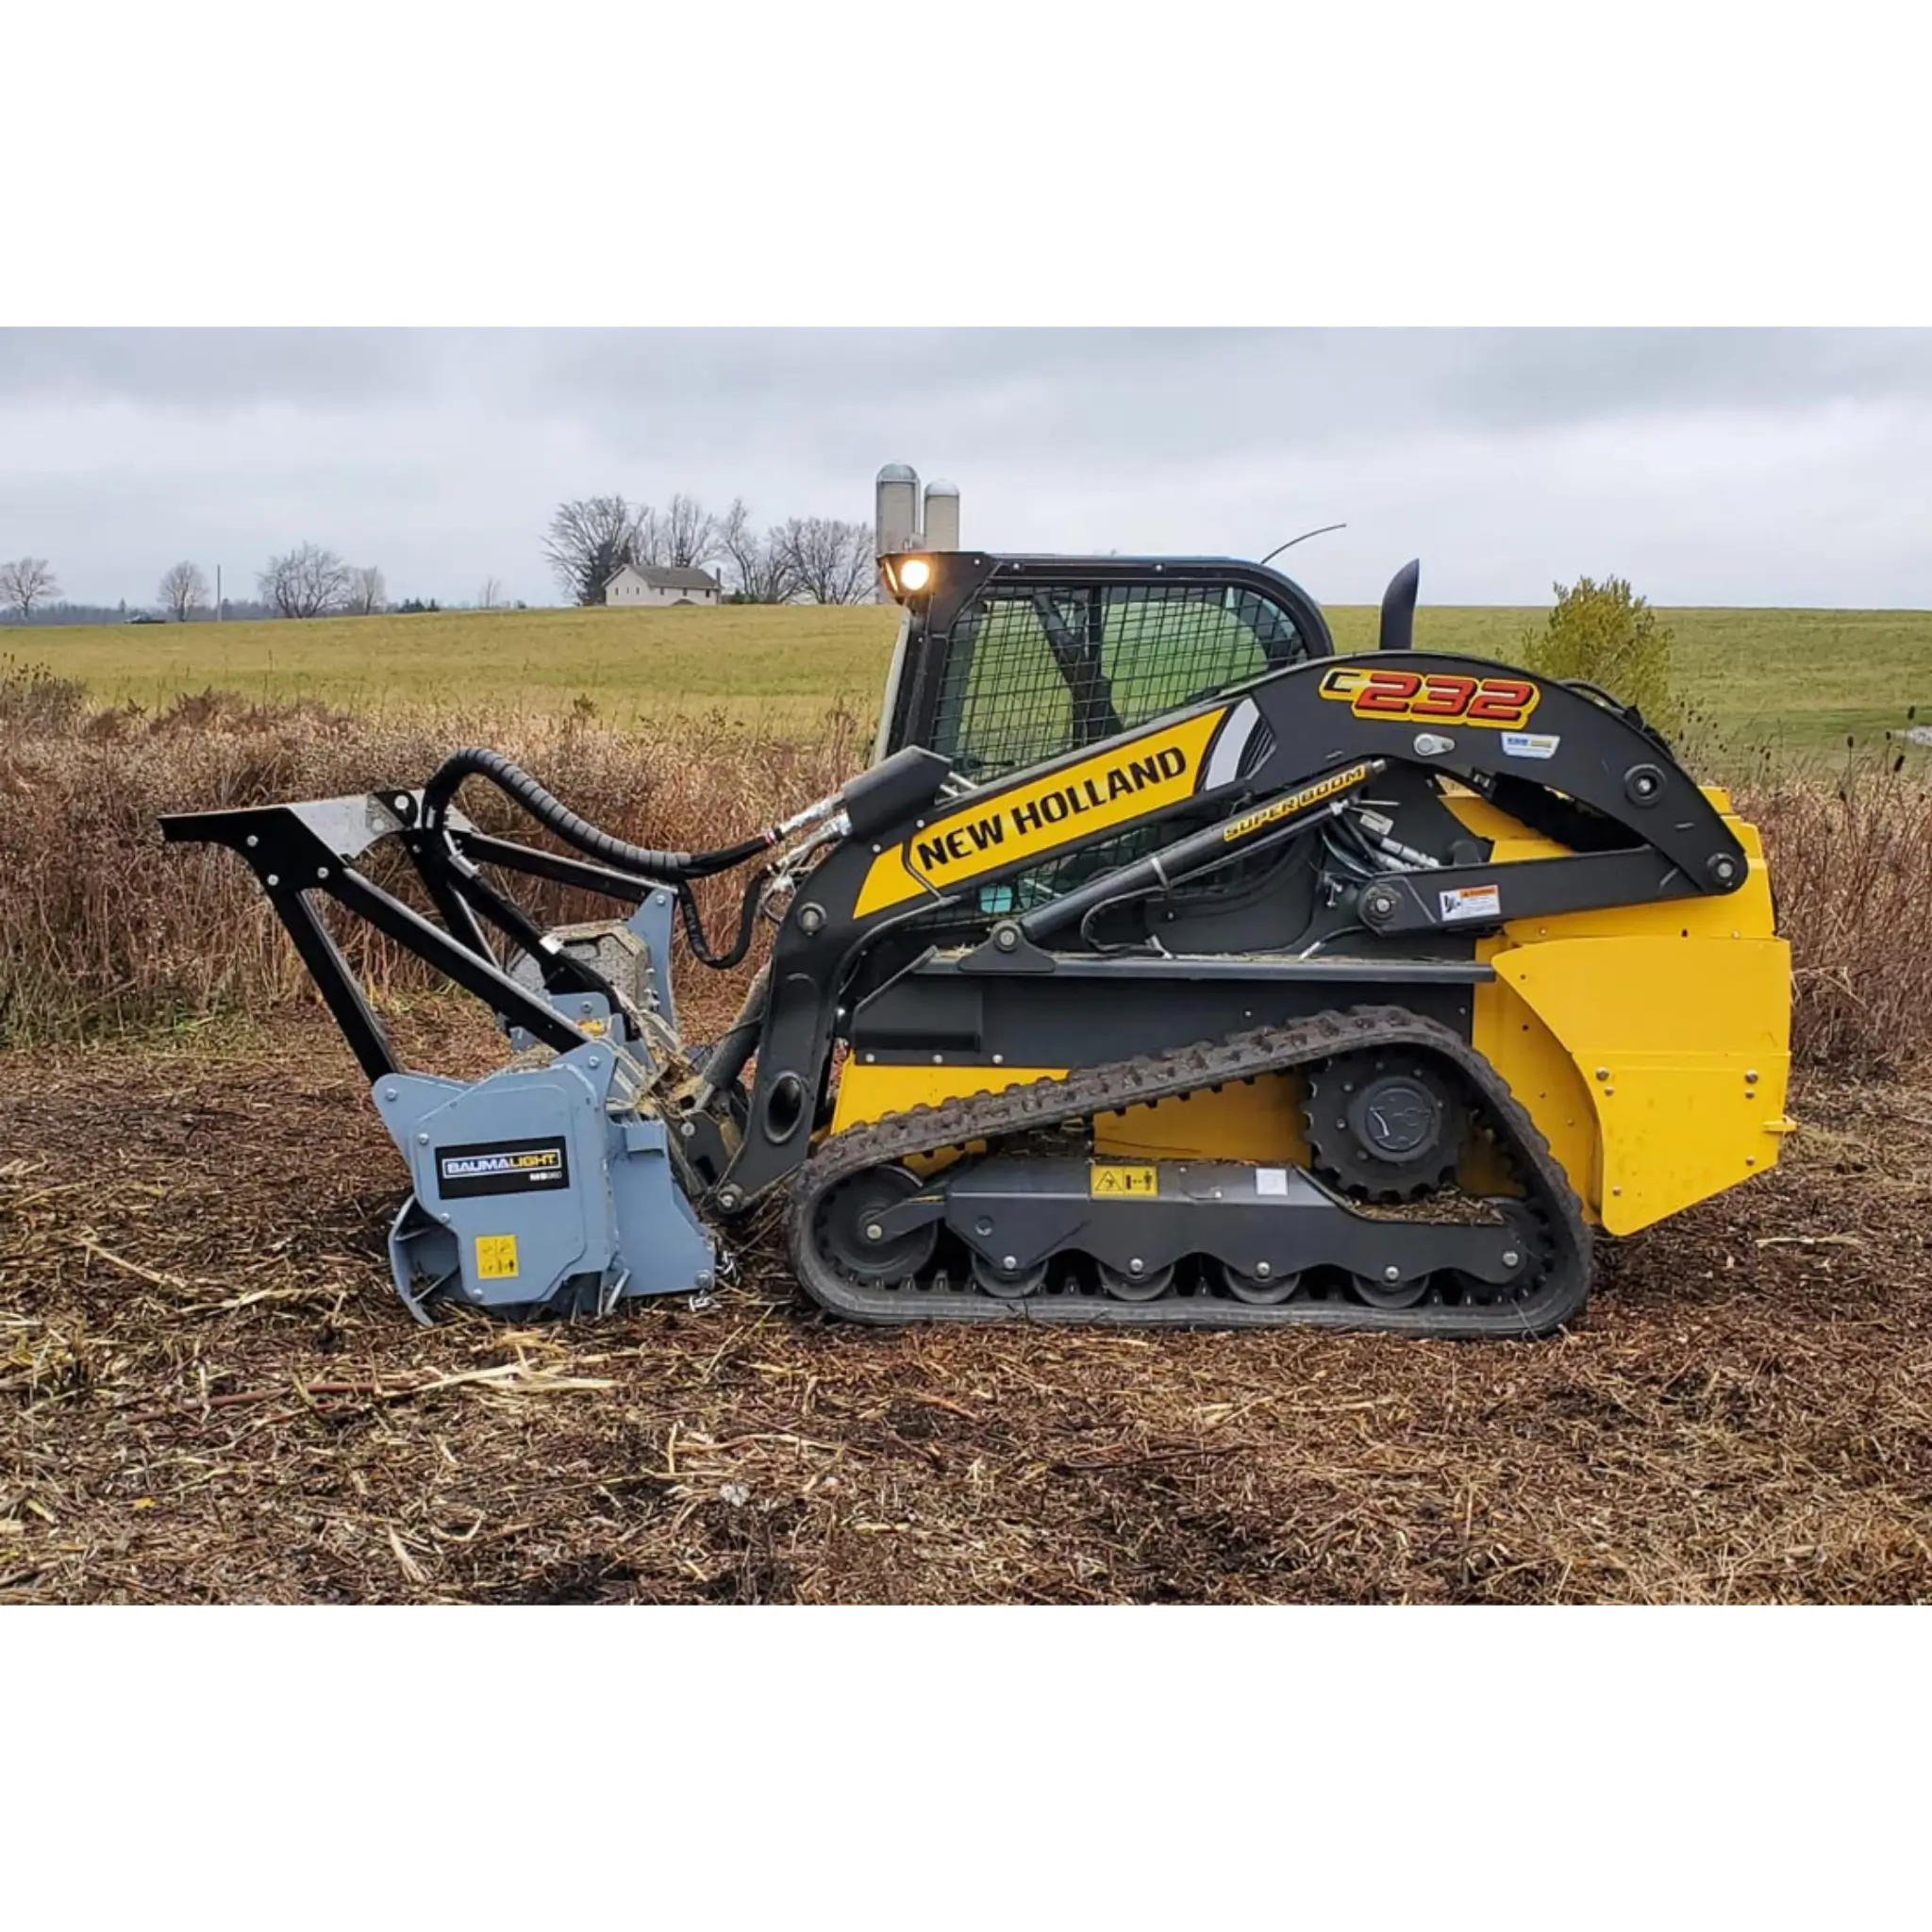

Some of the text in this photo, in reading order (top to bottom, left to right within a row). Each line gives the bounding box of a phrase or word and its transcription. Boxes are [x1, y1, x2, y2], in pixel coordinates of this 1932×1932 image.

[916, 746, 1187, 871] NEW HOLLAND
[447, 1153, 557, 1174] BAUMALIGHT
